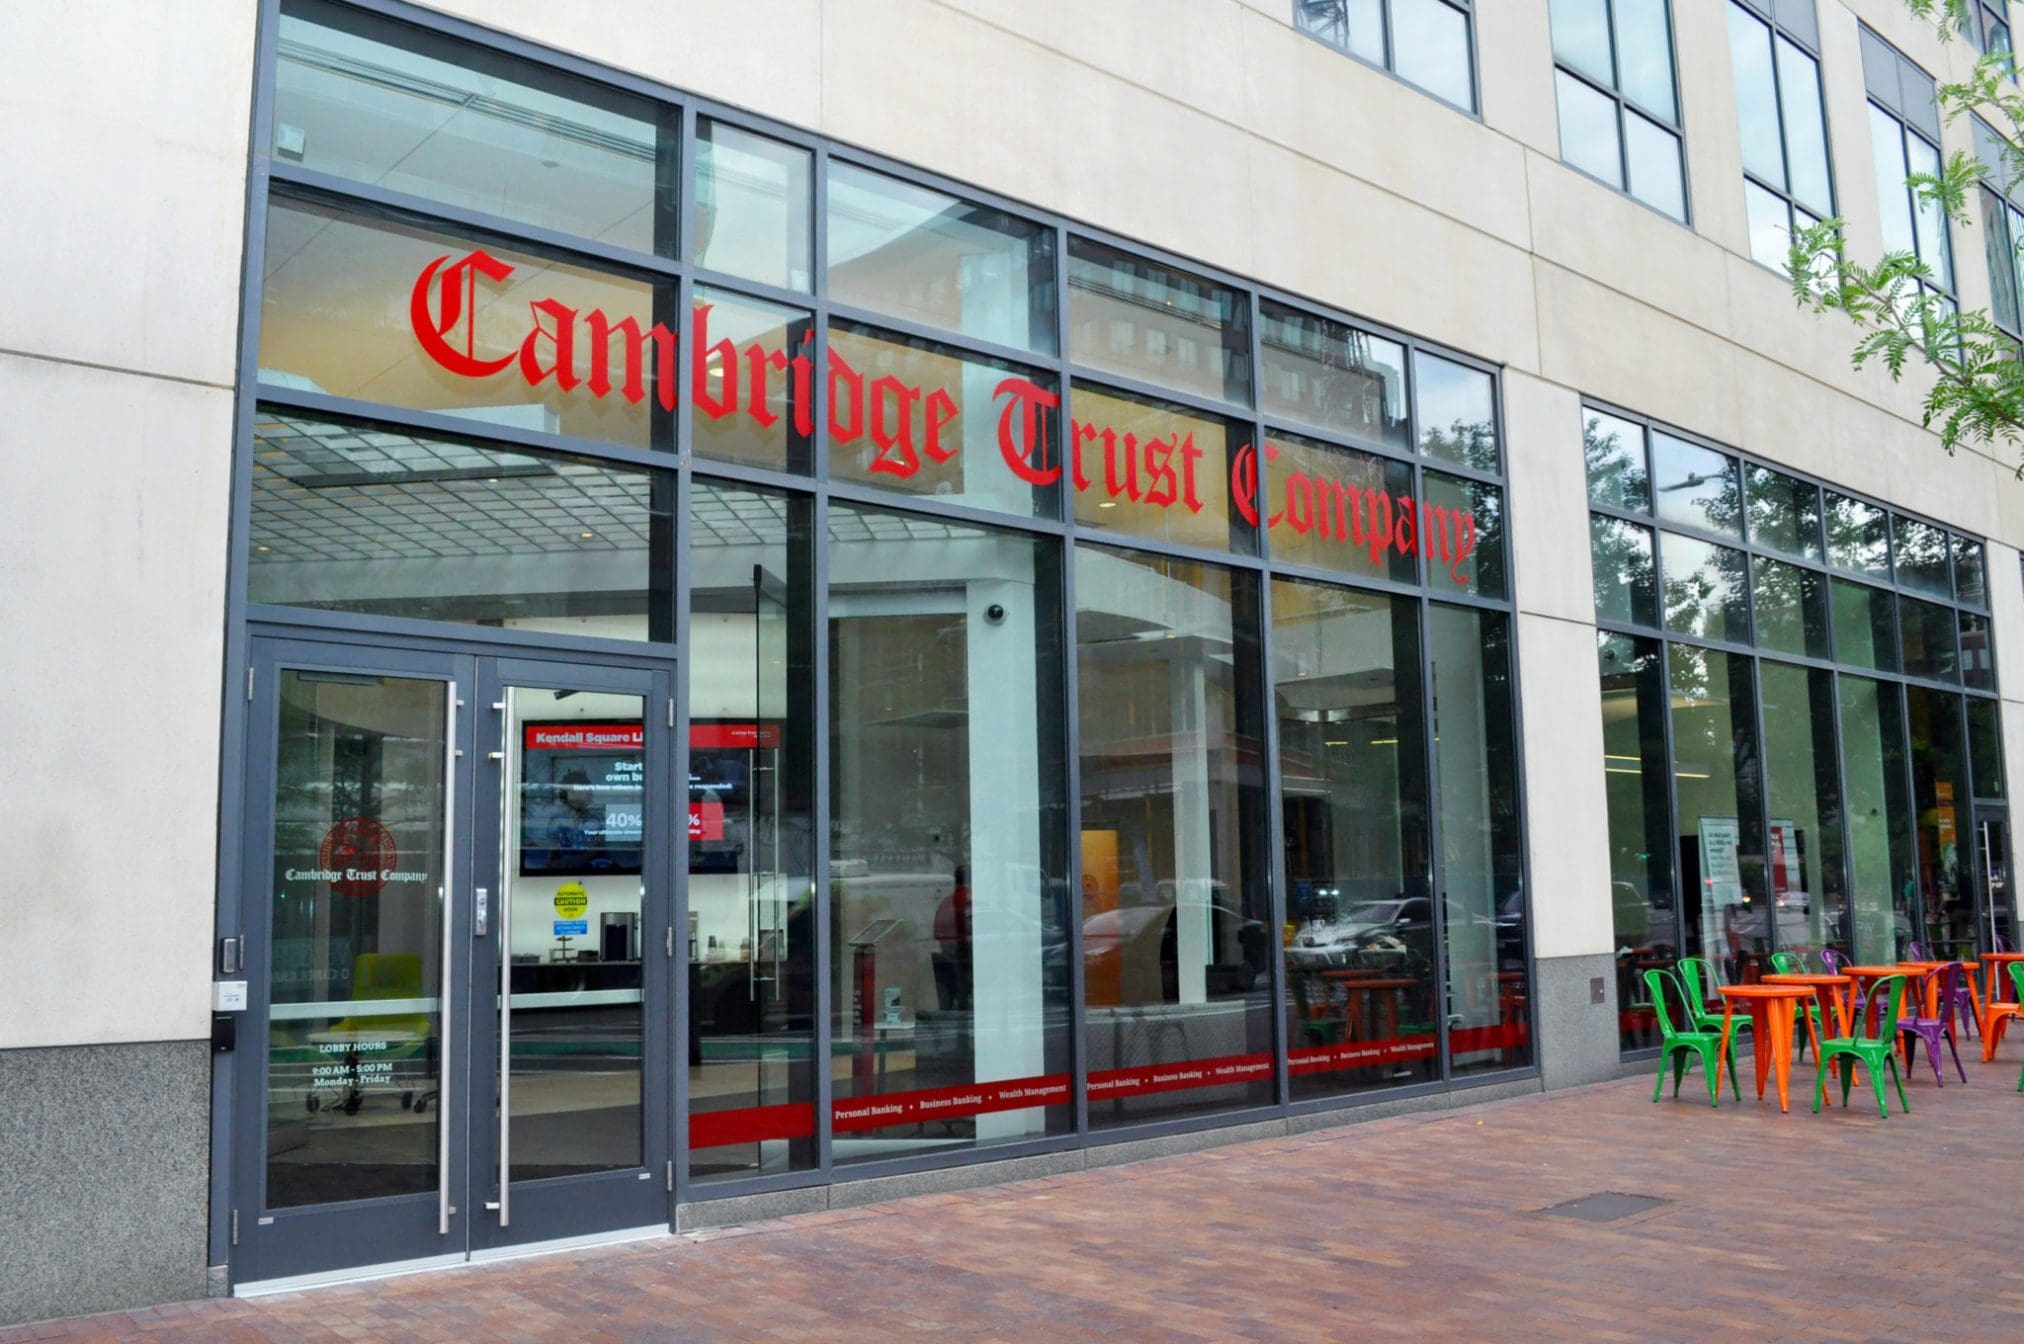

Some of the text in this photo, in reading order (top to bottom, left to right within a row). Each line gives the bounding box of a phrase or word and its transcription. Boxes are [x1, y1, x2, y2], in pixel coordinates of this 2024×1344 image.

[410, 249, 1476, 584] Cambridge Trust Company
[536, 732, 583, 743] Kendall
[586, 732, 630, 744] Square
[614, 761, 642, 771] Start
[605, 773, 630, 782] own
[606, 812, 642, 828] 40%
[285, 868, 428, 884] Cambridge Trust Company
[319, 1040, 387, 1053] LOBBY HOURS
[312, 1066, 331, 1076] 9:00
[332, 1065, 350, 1074] AM
[356, 1064, 375, 1073] 5:00
[376, 1062, 393, 1072] PM
[1086, 1062, 1270, 1090] Personal Banking Business Banking Wealth Management
[313, 1077, 354, 1087] Monday
[360, 1075, 391, 1084] Friday
[835, 1084, 1067, 1120] Personal Banking Business Banking Wealth Management
